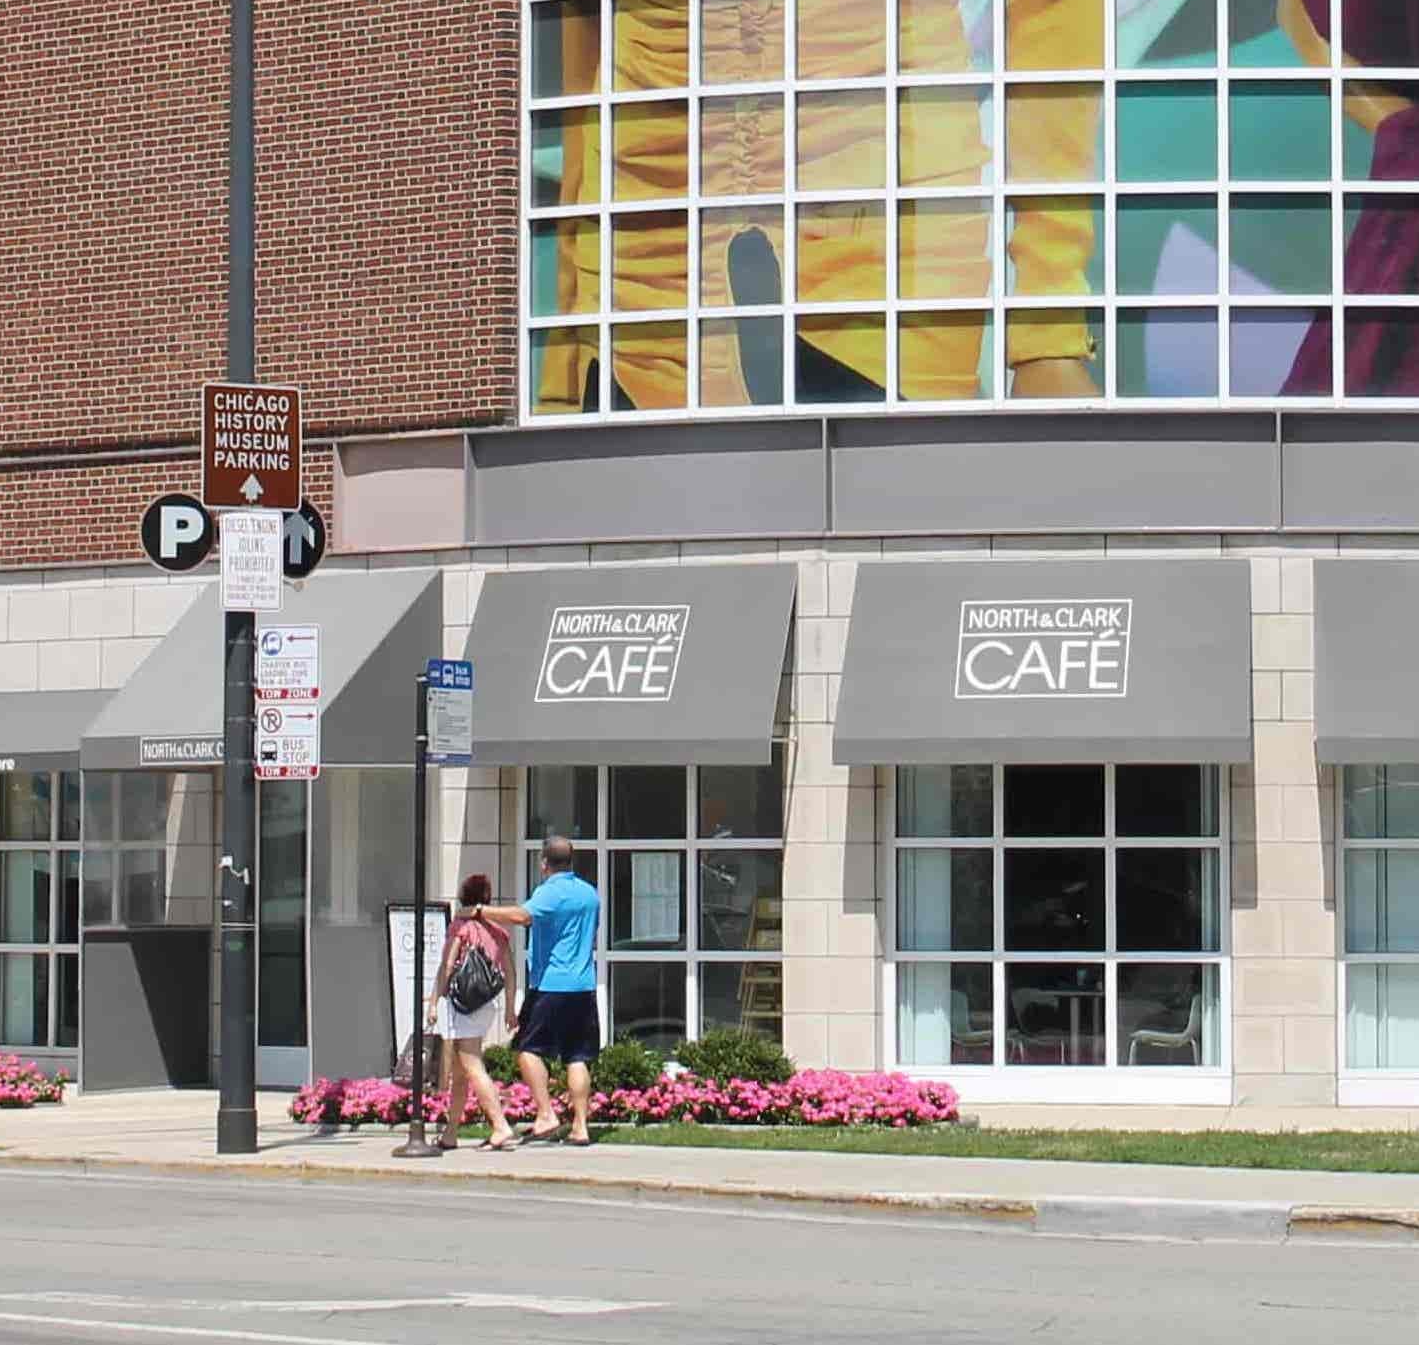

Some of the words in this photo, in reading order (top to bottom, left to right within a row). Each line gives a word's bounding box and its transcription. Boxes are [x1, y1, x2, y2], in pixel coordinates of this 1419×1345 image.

[214, 393, 290, 413] CHICAGO
[214, 412, 288, 431] HISTORY
[215, 432, 290, 452] MUSEUM
[214, 451, 291, 471] PARKING
[160, 506, 204, 558] P
[546, 633, 675, 694] CAFÉ
[965, 628, 1121, 690] CAFÉ
[261, 688, 282, 699] TOW
[286, 688, 312, 699] ZONE
[282, 739, 304, 751] BUS
[282, 752, 310, 763] STOP
[261, 767, 281, 777] TOW
[286, 767, 312, 777] ZONE
